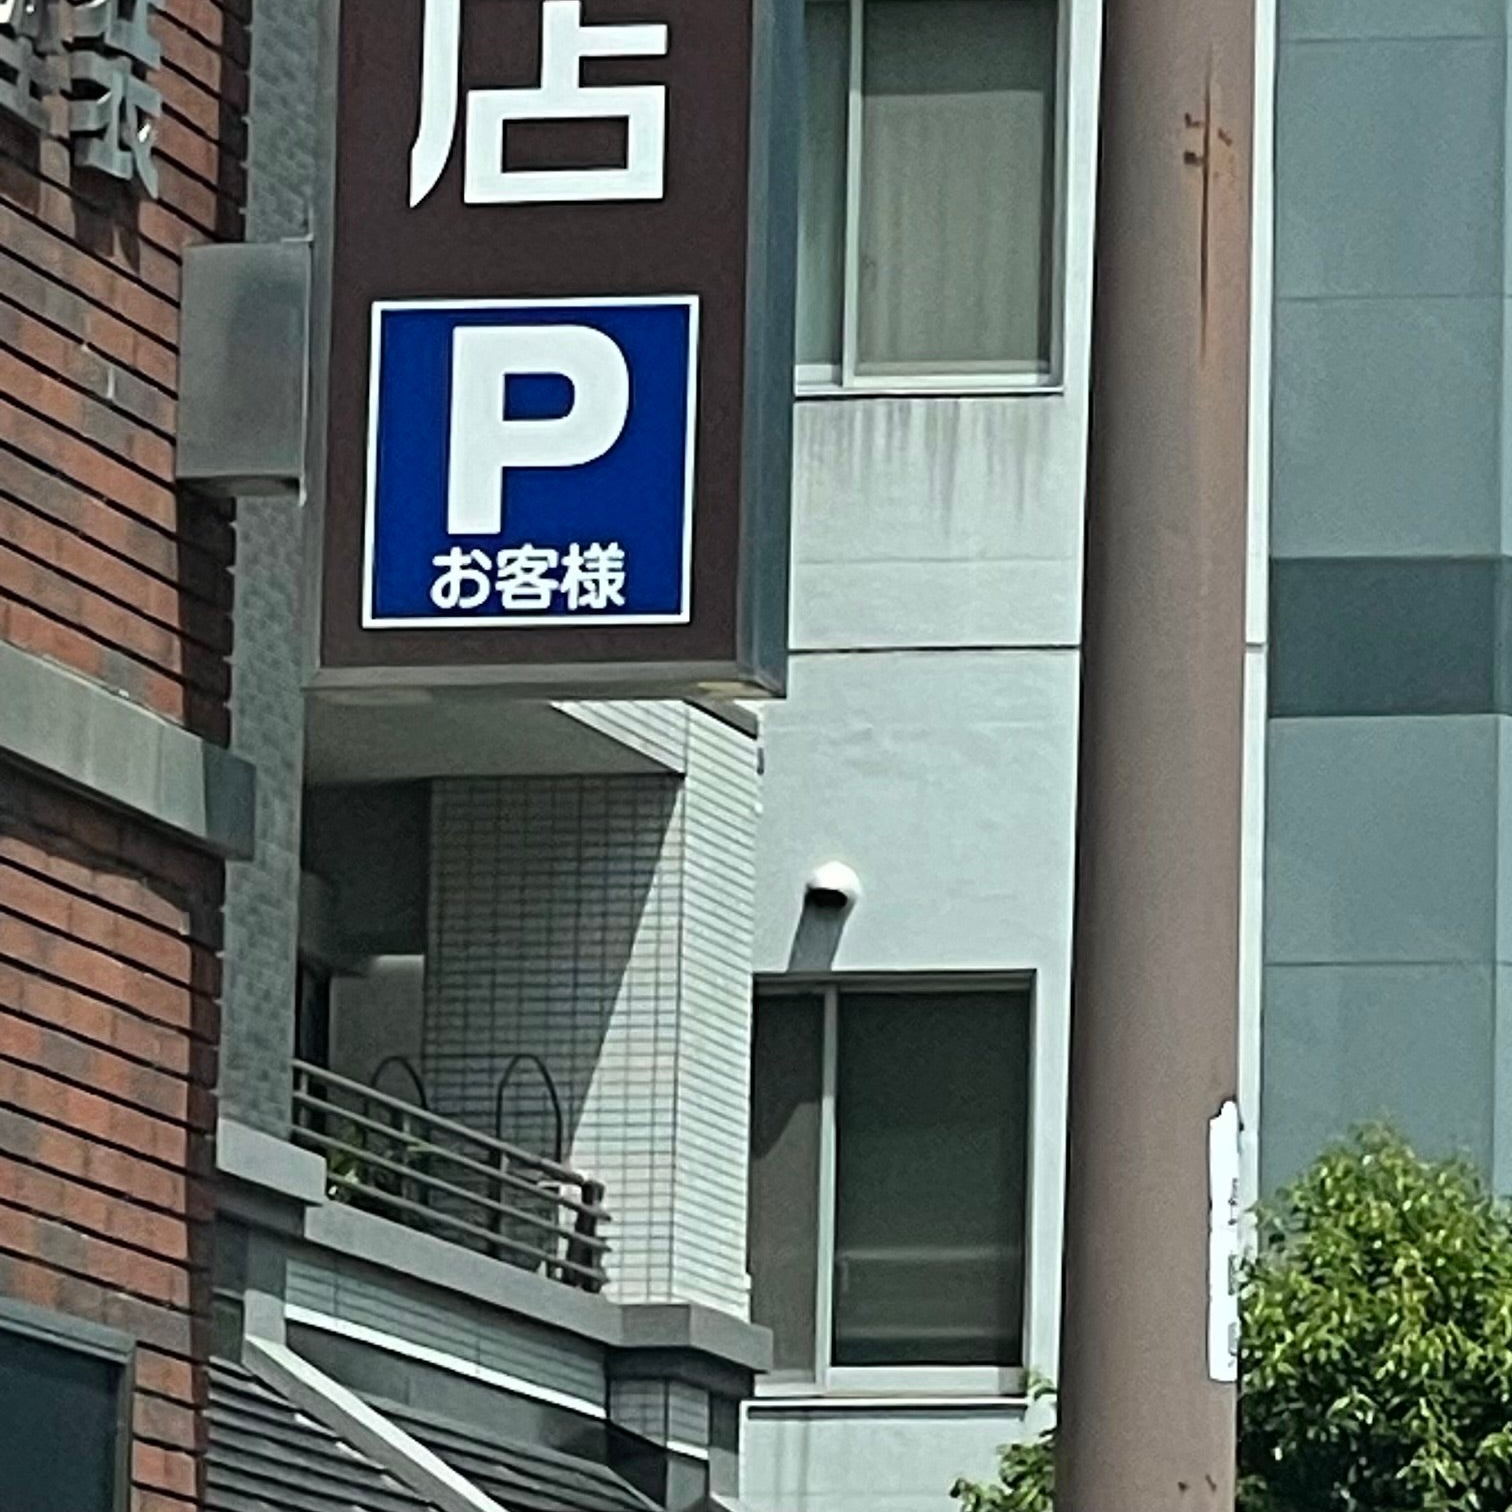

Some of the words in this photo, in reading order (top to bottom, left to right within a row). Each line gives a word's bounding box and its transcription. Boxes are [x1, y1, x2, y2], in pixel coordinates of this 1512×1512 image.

[447, 325, 630, 535] P
[430, 542, 626, 610] お客様
